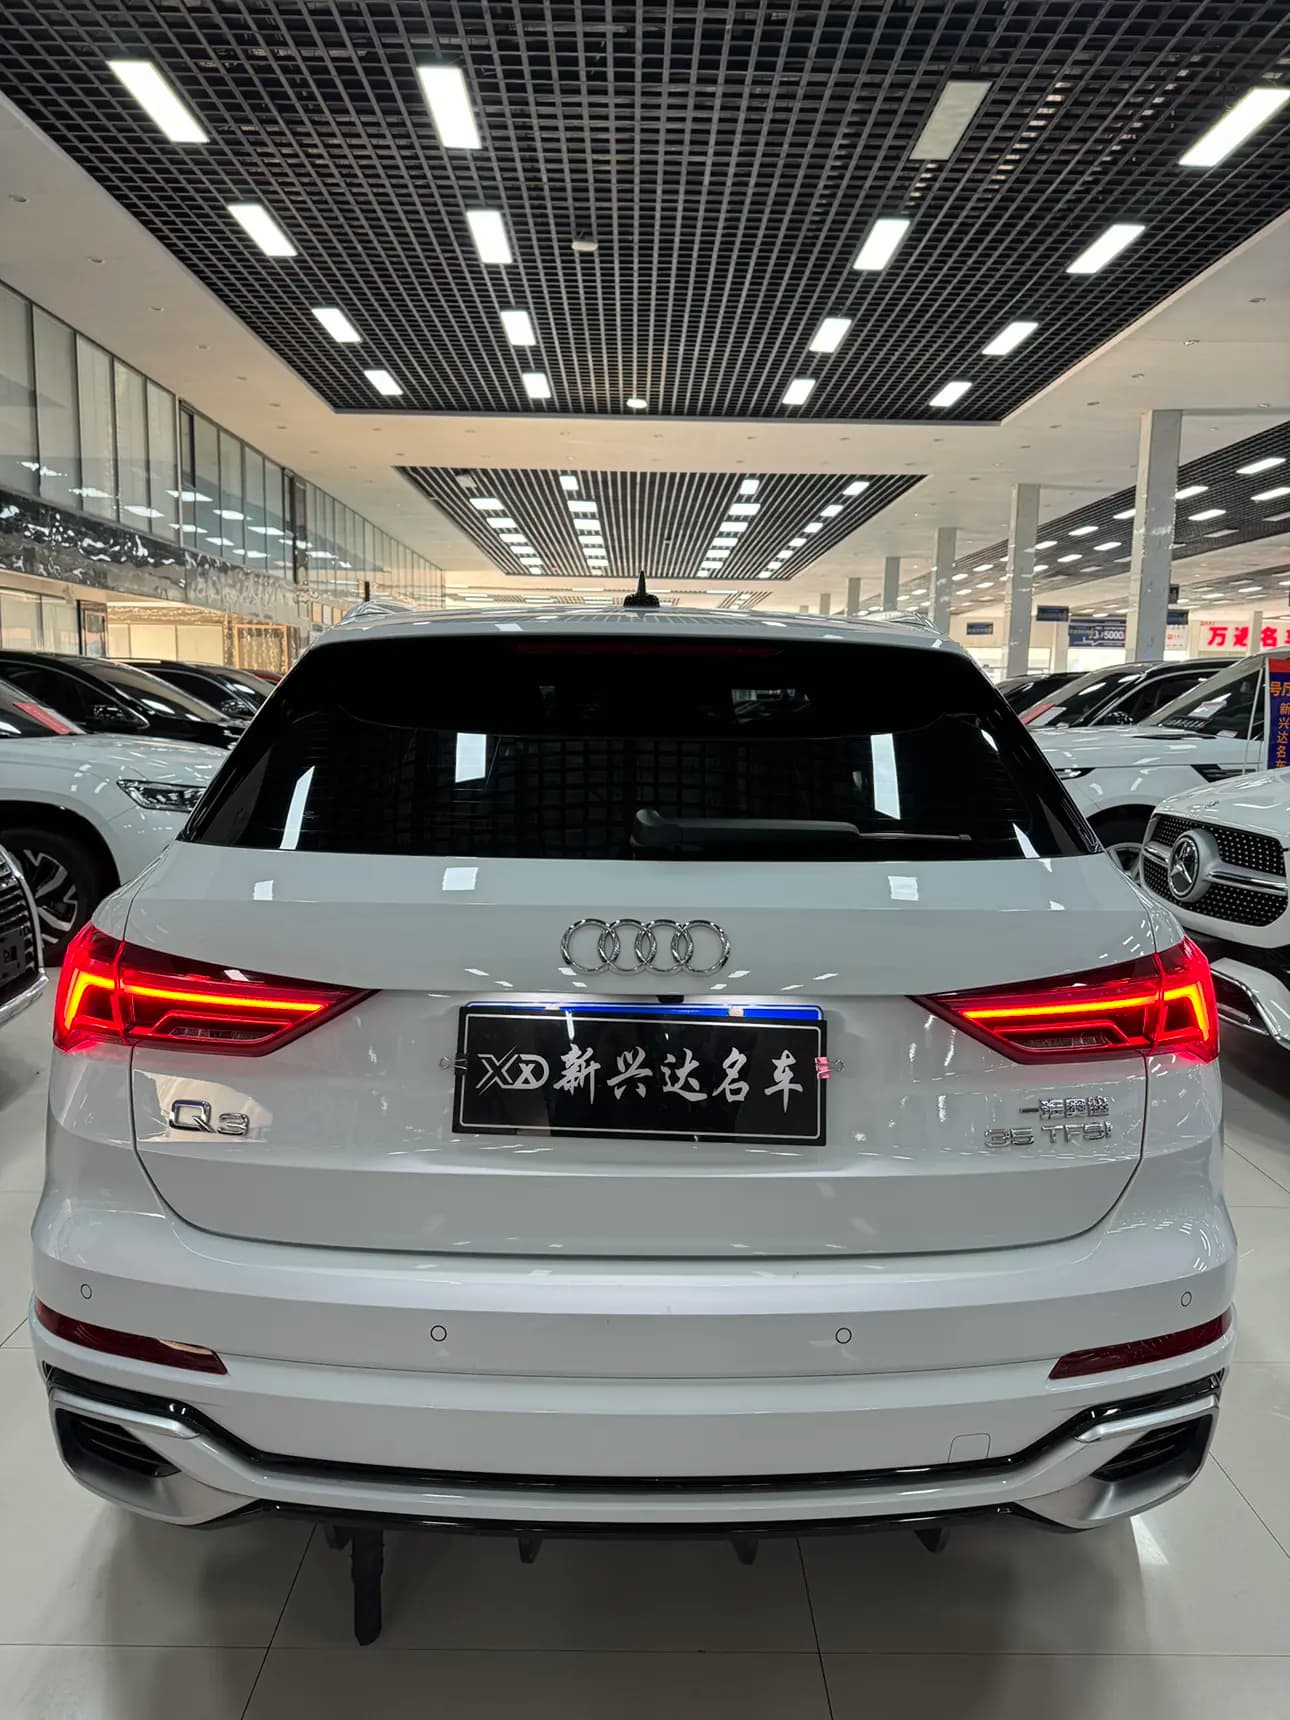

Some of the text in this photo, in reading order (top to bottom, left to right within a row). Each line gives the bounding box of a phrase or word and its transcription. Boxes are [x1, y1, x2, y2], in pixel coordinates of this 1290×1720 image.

[553, 1042, 804, 1113] 新兴达名车
[168, 1099, 250, 1136] Q3
[984, 1121, 1113, 1148] 35 TFSI
